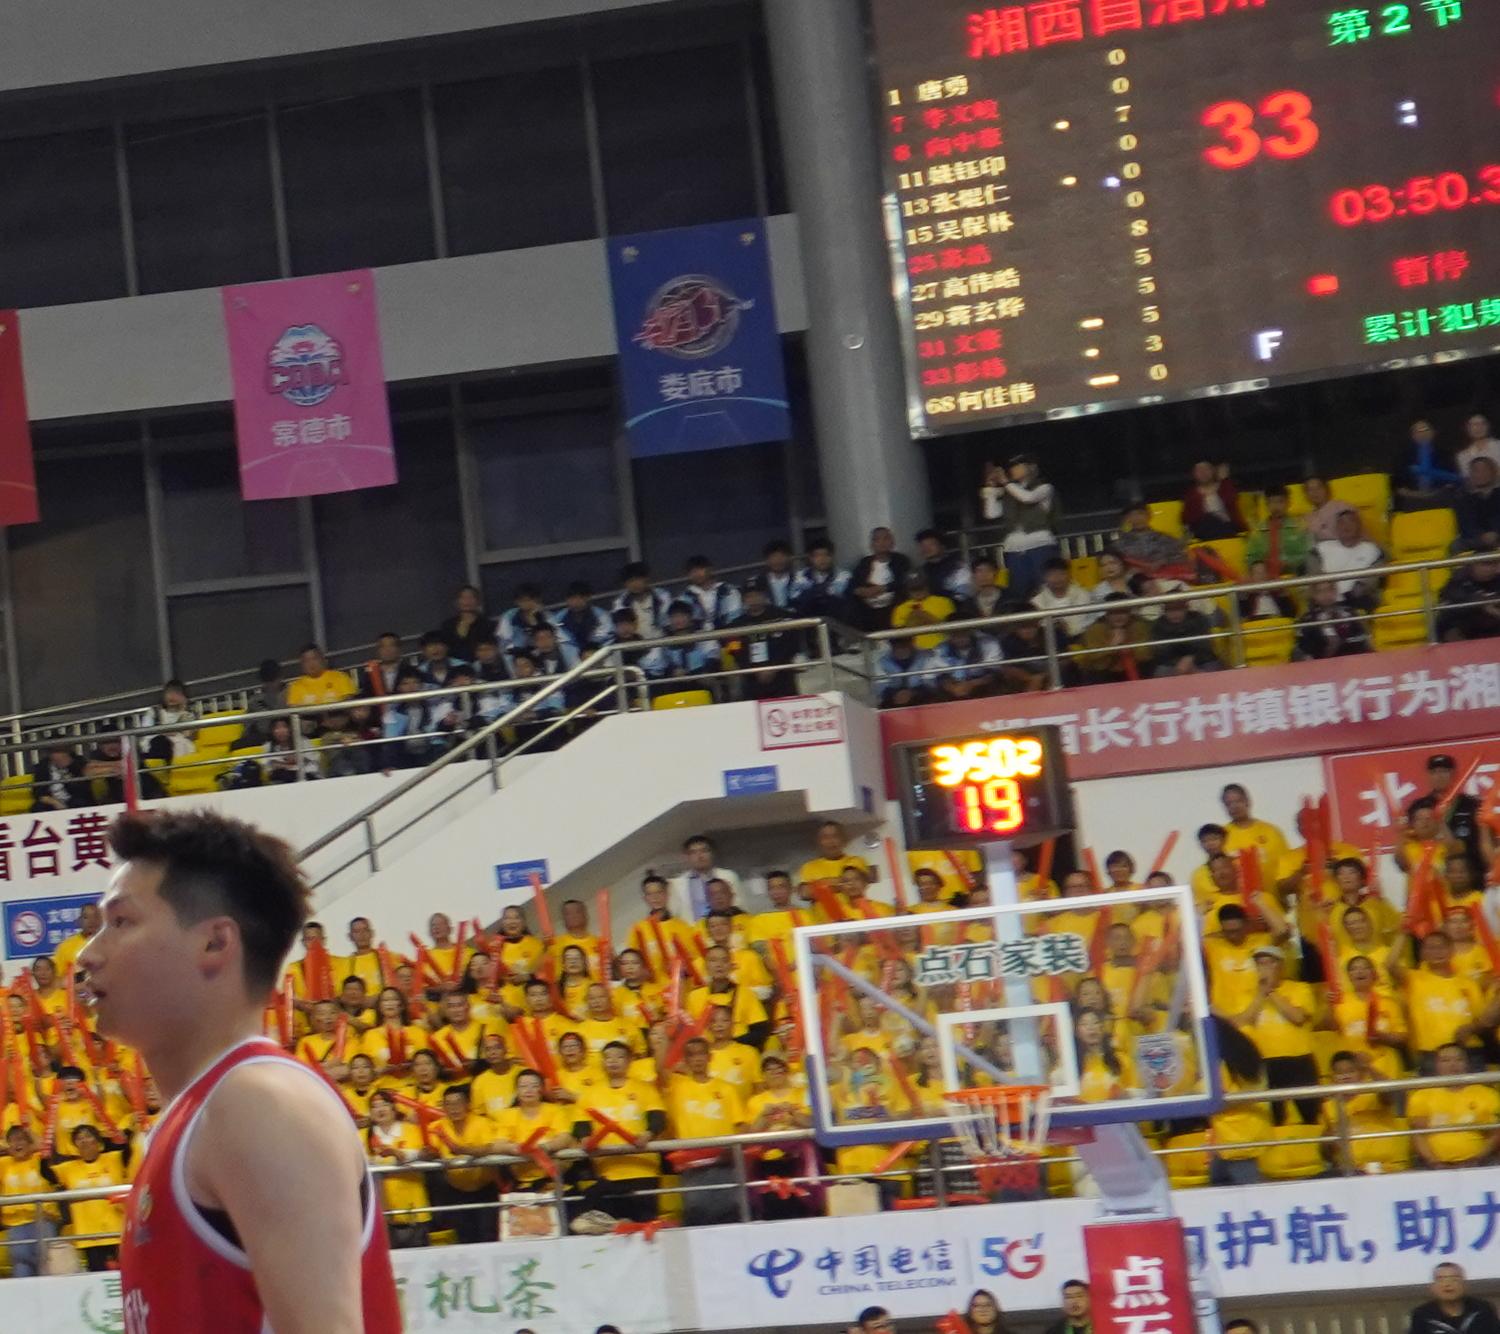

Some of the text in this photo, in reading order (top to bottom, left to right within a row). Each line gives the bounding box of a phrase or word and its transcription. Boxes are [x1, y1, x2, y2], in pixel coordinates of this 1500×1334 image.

[1202, 90, 1319, 169] 33
[1393, 251, 1470, 287] 暂停
[967, 779, 1023, 833] 19
[916, 934, 1091, 986] 点石家装
[814, 1238, 955, 1276] 中国电信
[979, 1232, 1047, 1281] 5G
